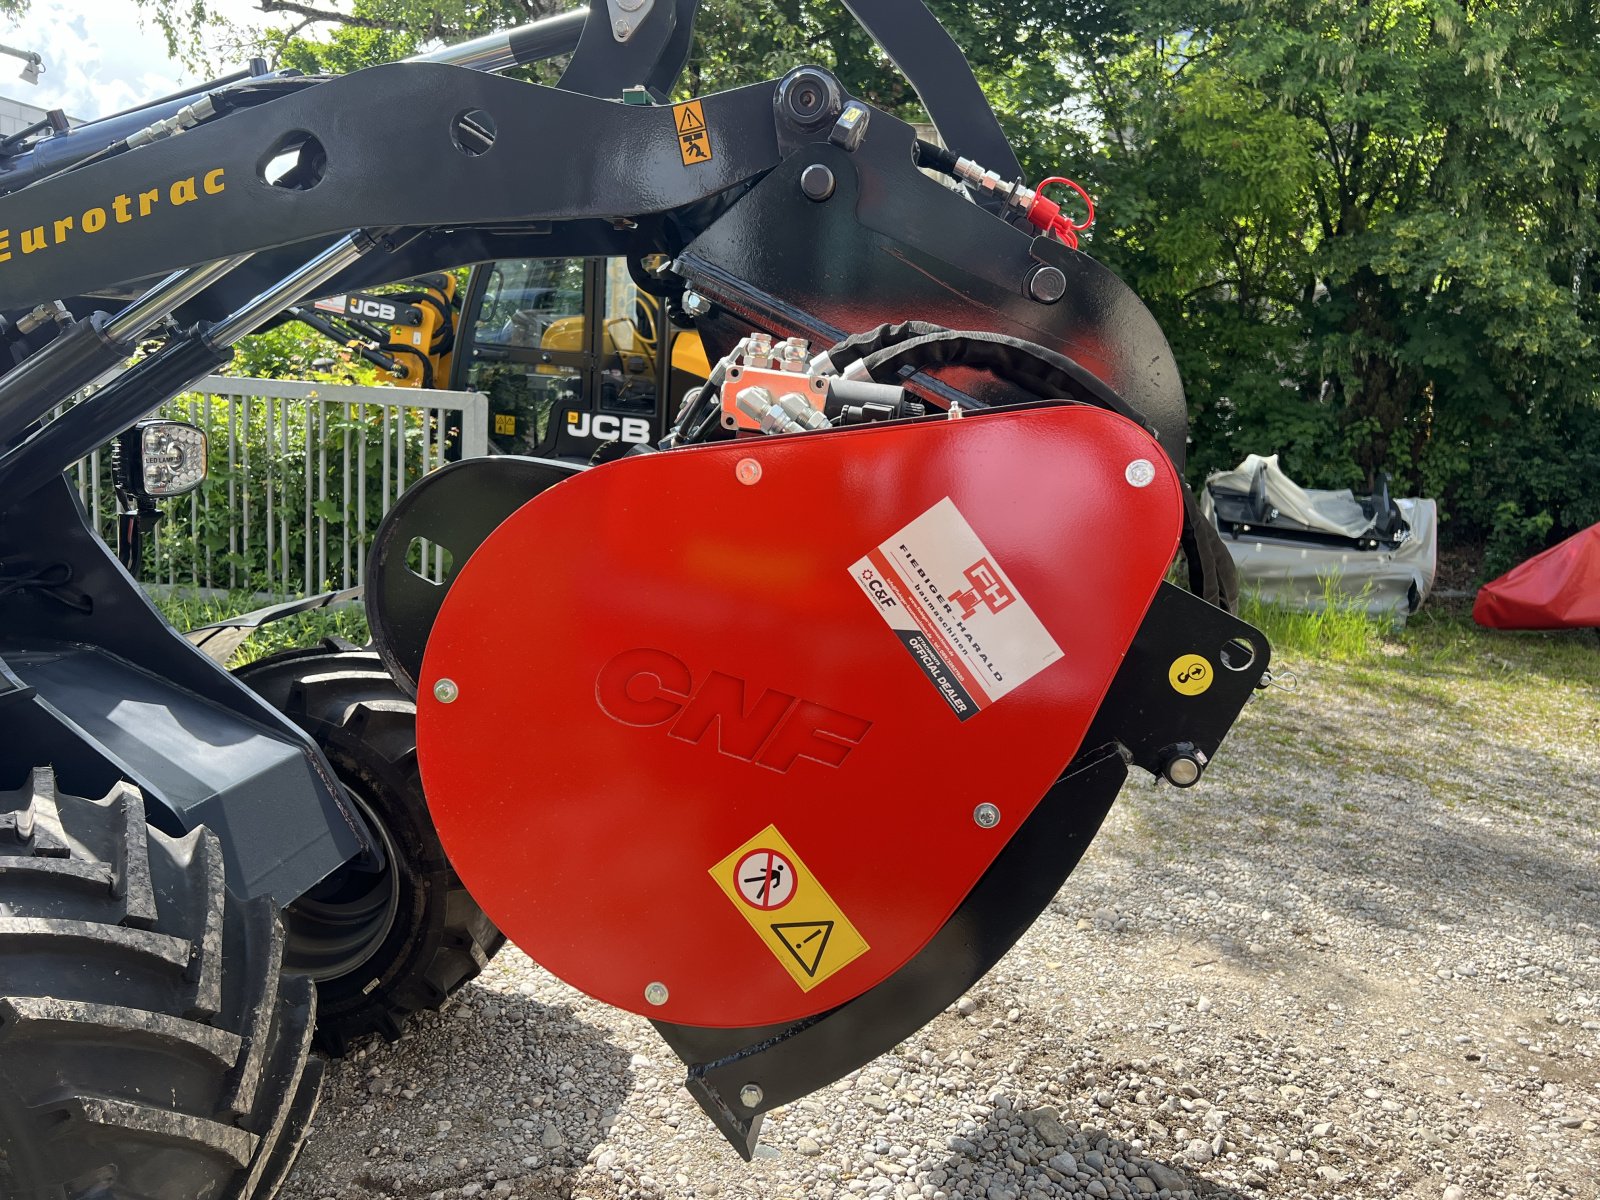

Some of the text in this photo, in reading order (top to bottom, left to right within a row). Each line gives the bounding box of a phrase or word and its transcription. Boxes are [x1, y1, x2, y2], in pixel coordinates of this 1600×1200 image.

[349, 298, 396, 321] JCB
[567, 412, 650, 445] JCB
[868, 579, 897, 608] C&F
[970, 564, 1010, 608] FH
[913, 582, 969, 656] baumaschinen
[915, 635, 941, 666] ATTACHMENTS
[908, 637, 941, 678] OFFICIAL
[936, 675, 968, 713] DEALER
[595, 647, 873, 774] CNF
